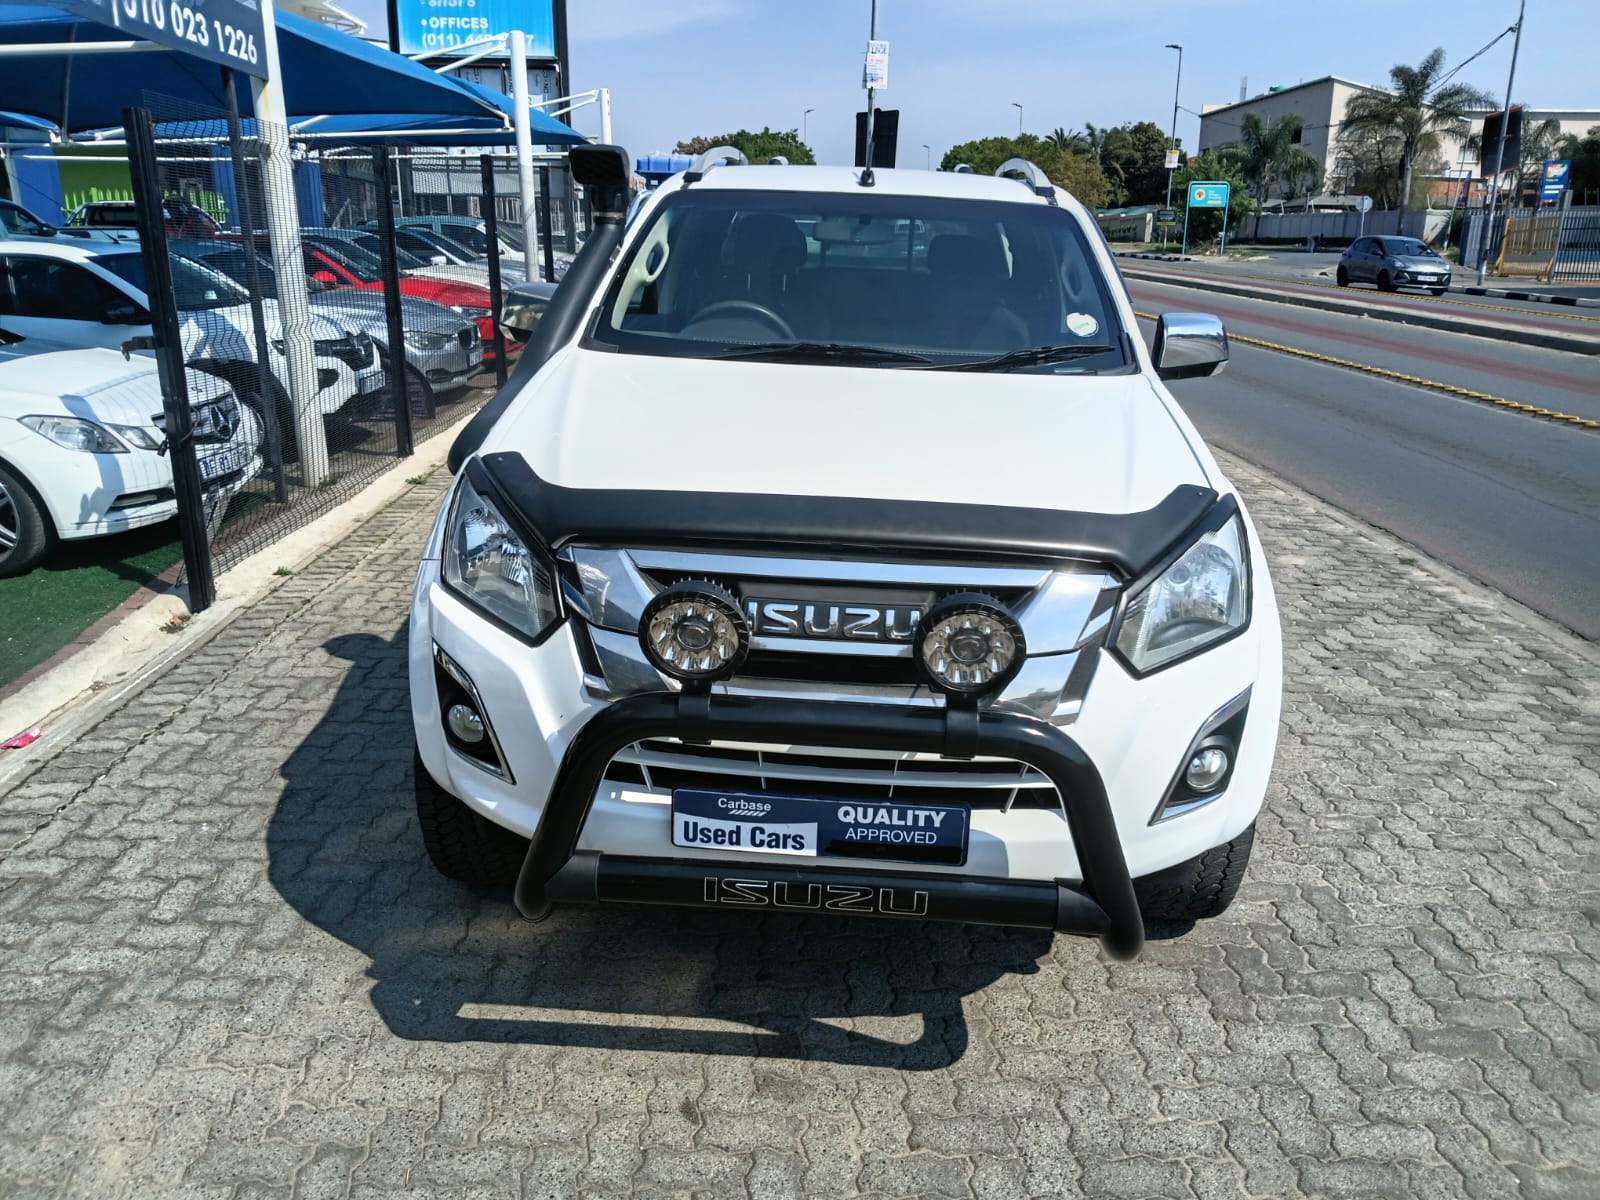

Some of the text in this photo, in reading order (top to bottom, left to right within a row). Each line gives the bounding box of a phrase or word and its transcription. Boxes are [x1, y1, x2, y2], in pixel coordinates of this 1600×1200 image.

[170, 1, 209, 47] 023
[214, 20, 258, 65] 1226
[429, 17, 489, 29] OFFICES
[421, 33, 461, 49] (011)
[746, 601, 920, 640] ISUZU
[717, 797, 772, 812] Carbase
[837, 805, 947, 828] QUALITY
[683, 820, 806, 851] Used Cars
[844, 827, 938, 845] APPROVED
[703, 876, 929, 916] ISUZU
